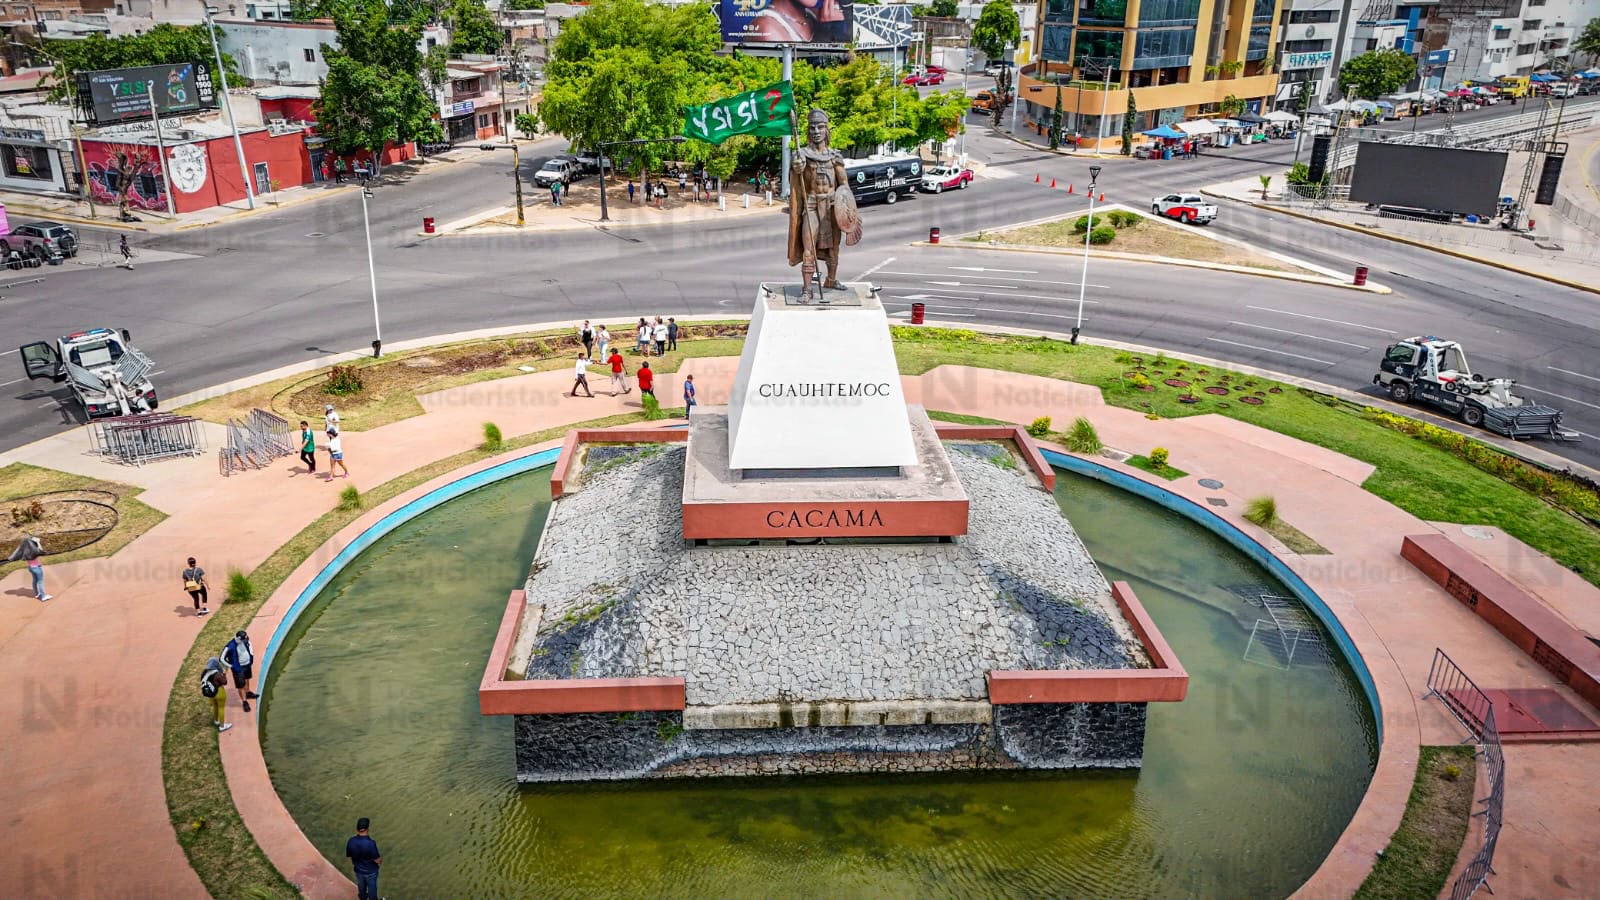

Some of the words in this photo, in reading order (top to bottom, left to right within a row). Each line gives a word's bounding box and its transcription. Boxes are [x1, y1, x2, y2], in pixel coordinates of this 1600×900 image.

[692, 107, 708, 136] Y
[760, 383, 890, 397] CUAUHTEMOC
[766, 509, 884, 528] CACAMA
